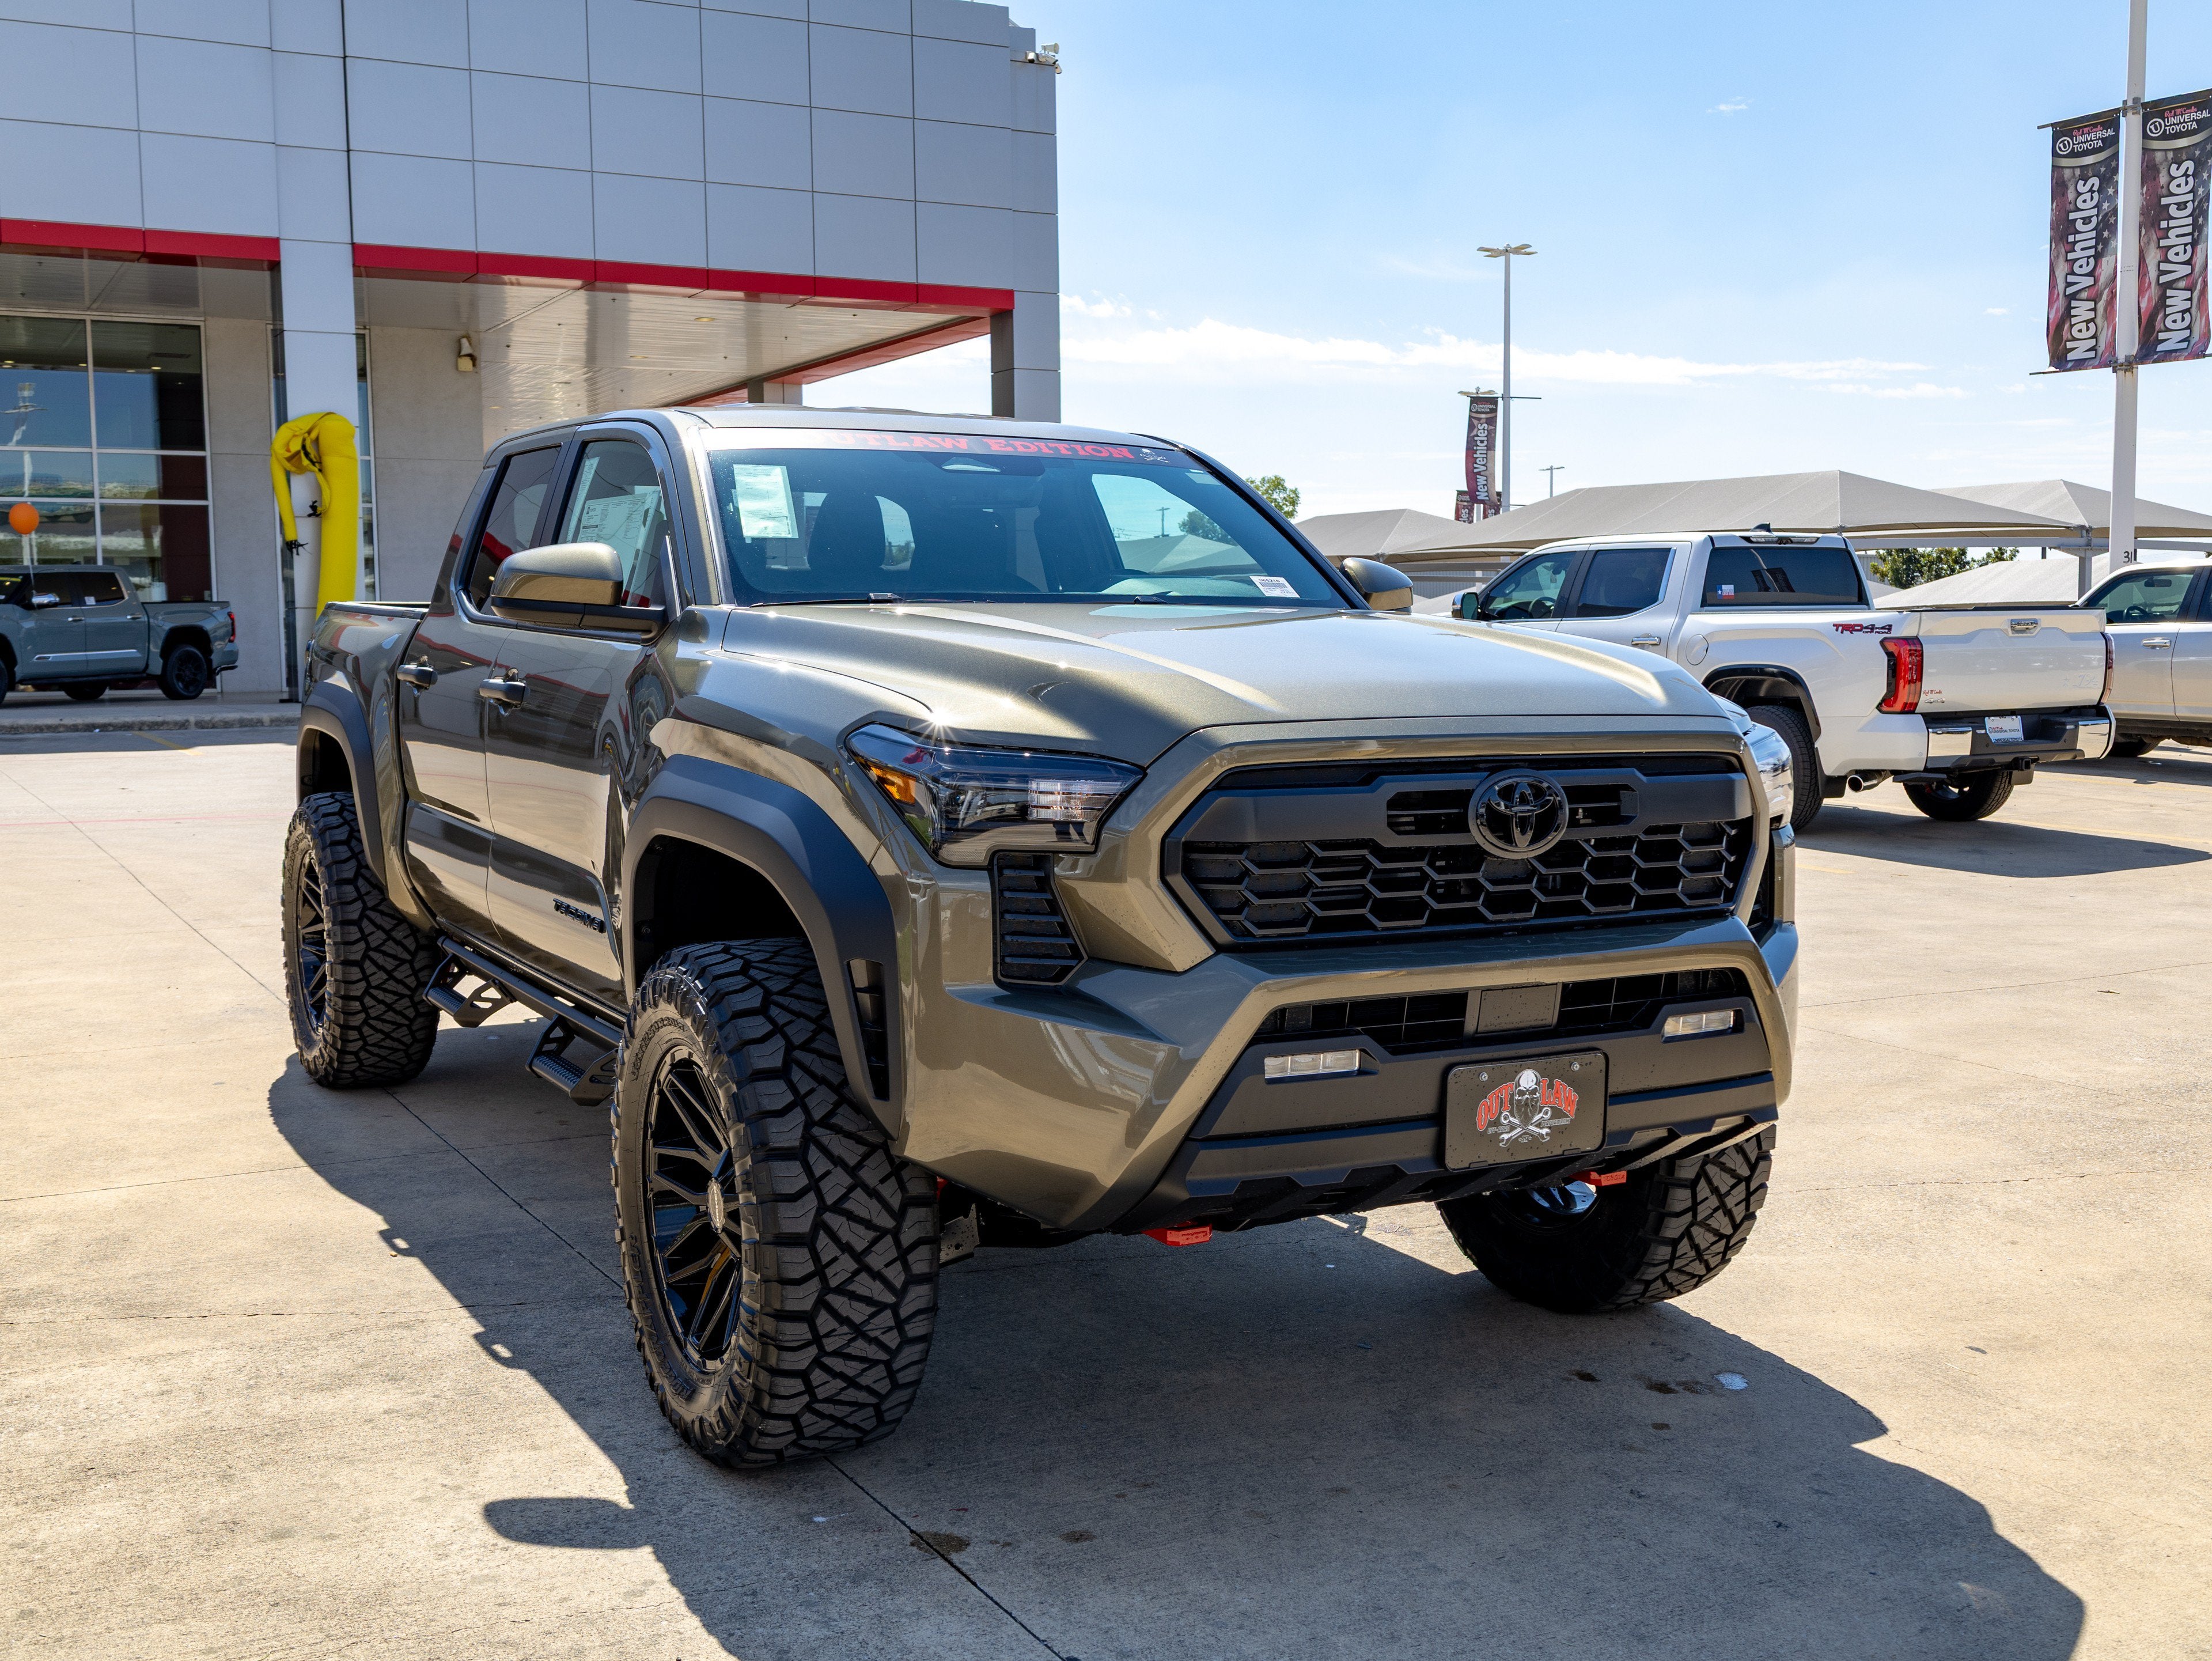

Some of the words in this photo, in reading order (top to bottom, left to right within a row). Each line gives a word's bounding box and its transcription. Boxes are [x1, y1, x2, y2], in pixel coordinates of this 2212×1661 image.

[2165, 109, 2211, 126] UNIVERSAL
[2073, 128, 2115, 144] UNIVERSAL
[2165, 121, 2198, 134] TOYOTA
[2073, 139, 2103, 152] TOYOTA
[2159, 160, 2195, 285] Vehicles
[2065, 176, 2100, 296] Vehicles
[2156, 289, 2191, 352] New
[2066, 300, 2097, 361] New
[982, 438, 1135, 459] EDITION
[1473, 422, 1488, 473] Vehicles
[1475, 474, 1490, 501] New
[2123, 550, 2133, 564] 31
[1832, 623, 1864, 634] TRD
[1487, 1125, 1511, 1134] OFF-ROAD
